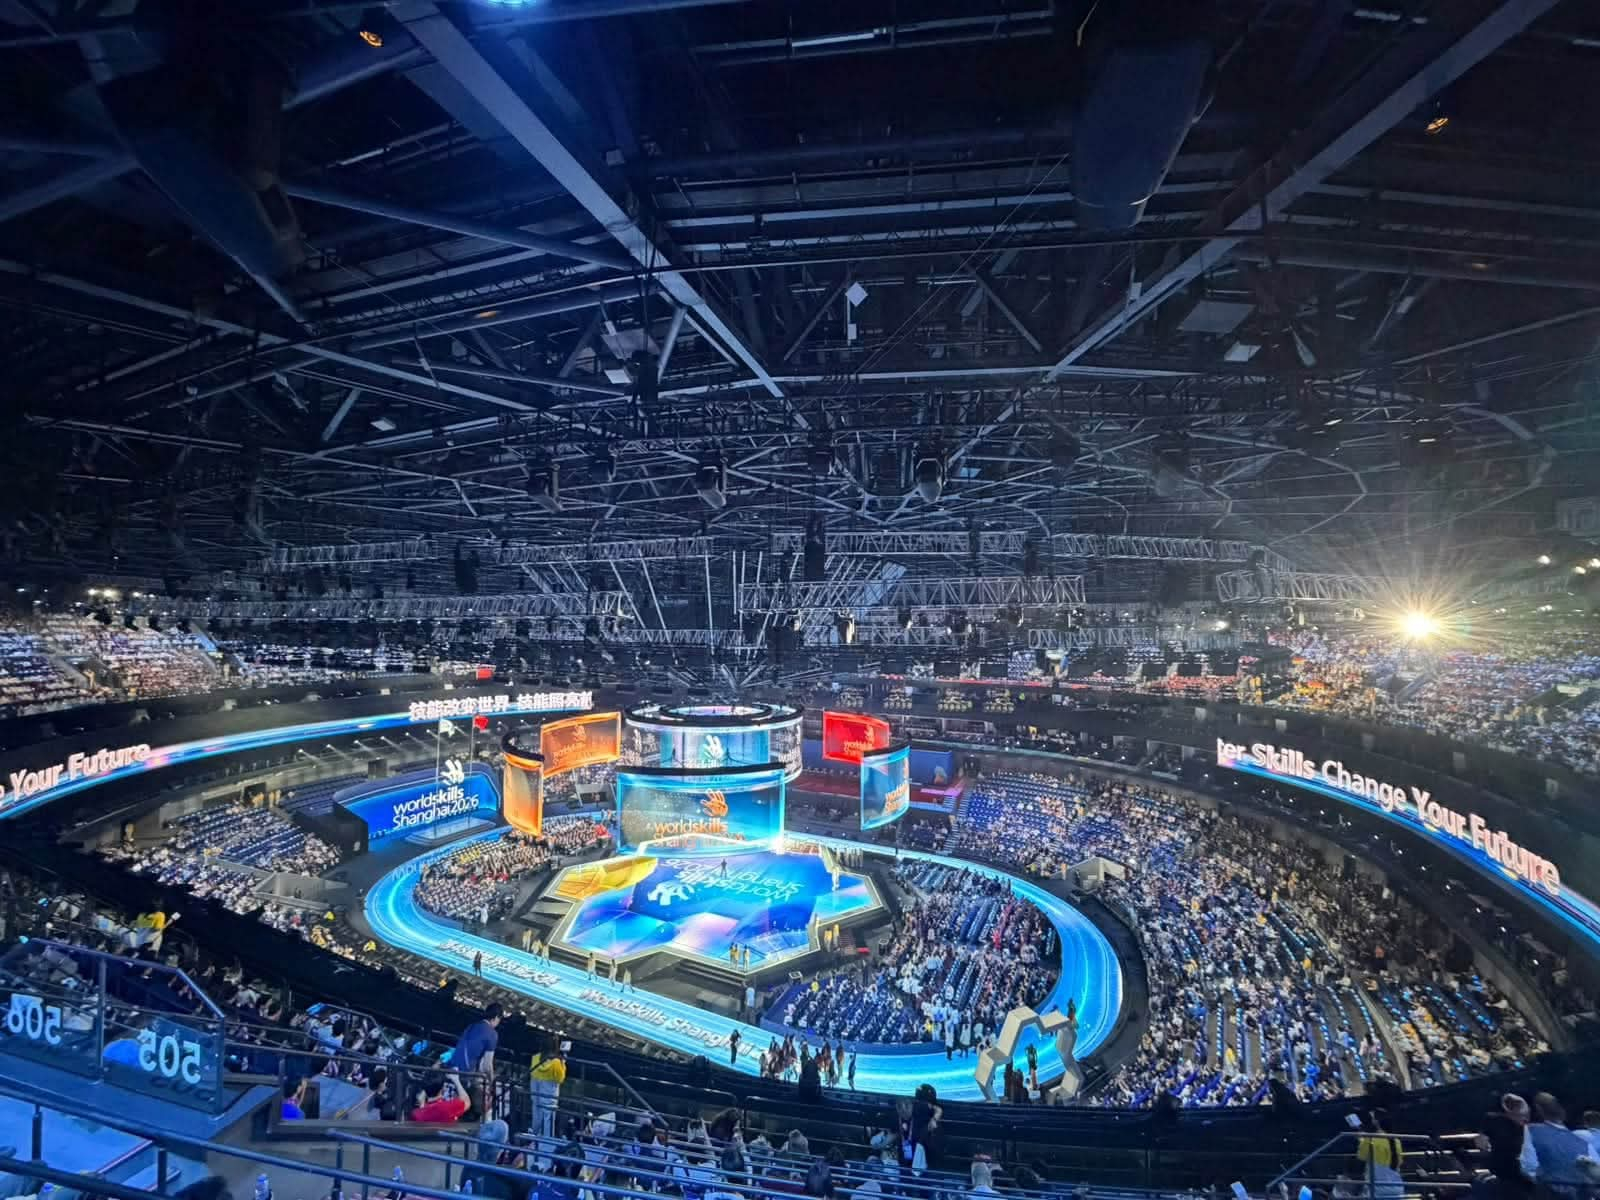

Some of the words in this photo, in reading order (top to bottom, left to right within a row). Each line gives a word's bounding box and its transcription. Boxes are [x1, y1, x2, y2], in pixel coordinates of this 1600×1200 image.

[10, 769, 64, 801] Your
[68, 744, 151, 780] Future
[393, 785, 464, 815] worldskills
[1252, 743, 1315, 779] Skills
[1322, 760, 1407, 812] Change
[1411, 786, 1466, 836] Your
[1469, 813, 1560, 895] Future
[655, 817, 728, 834] worldskills
